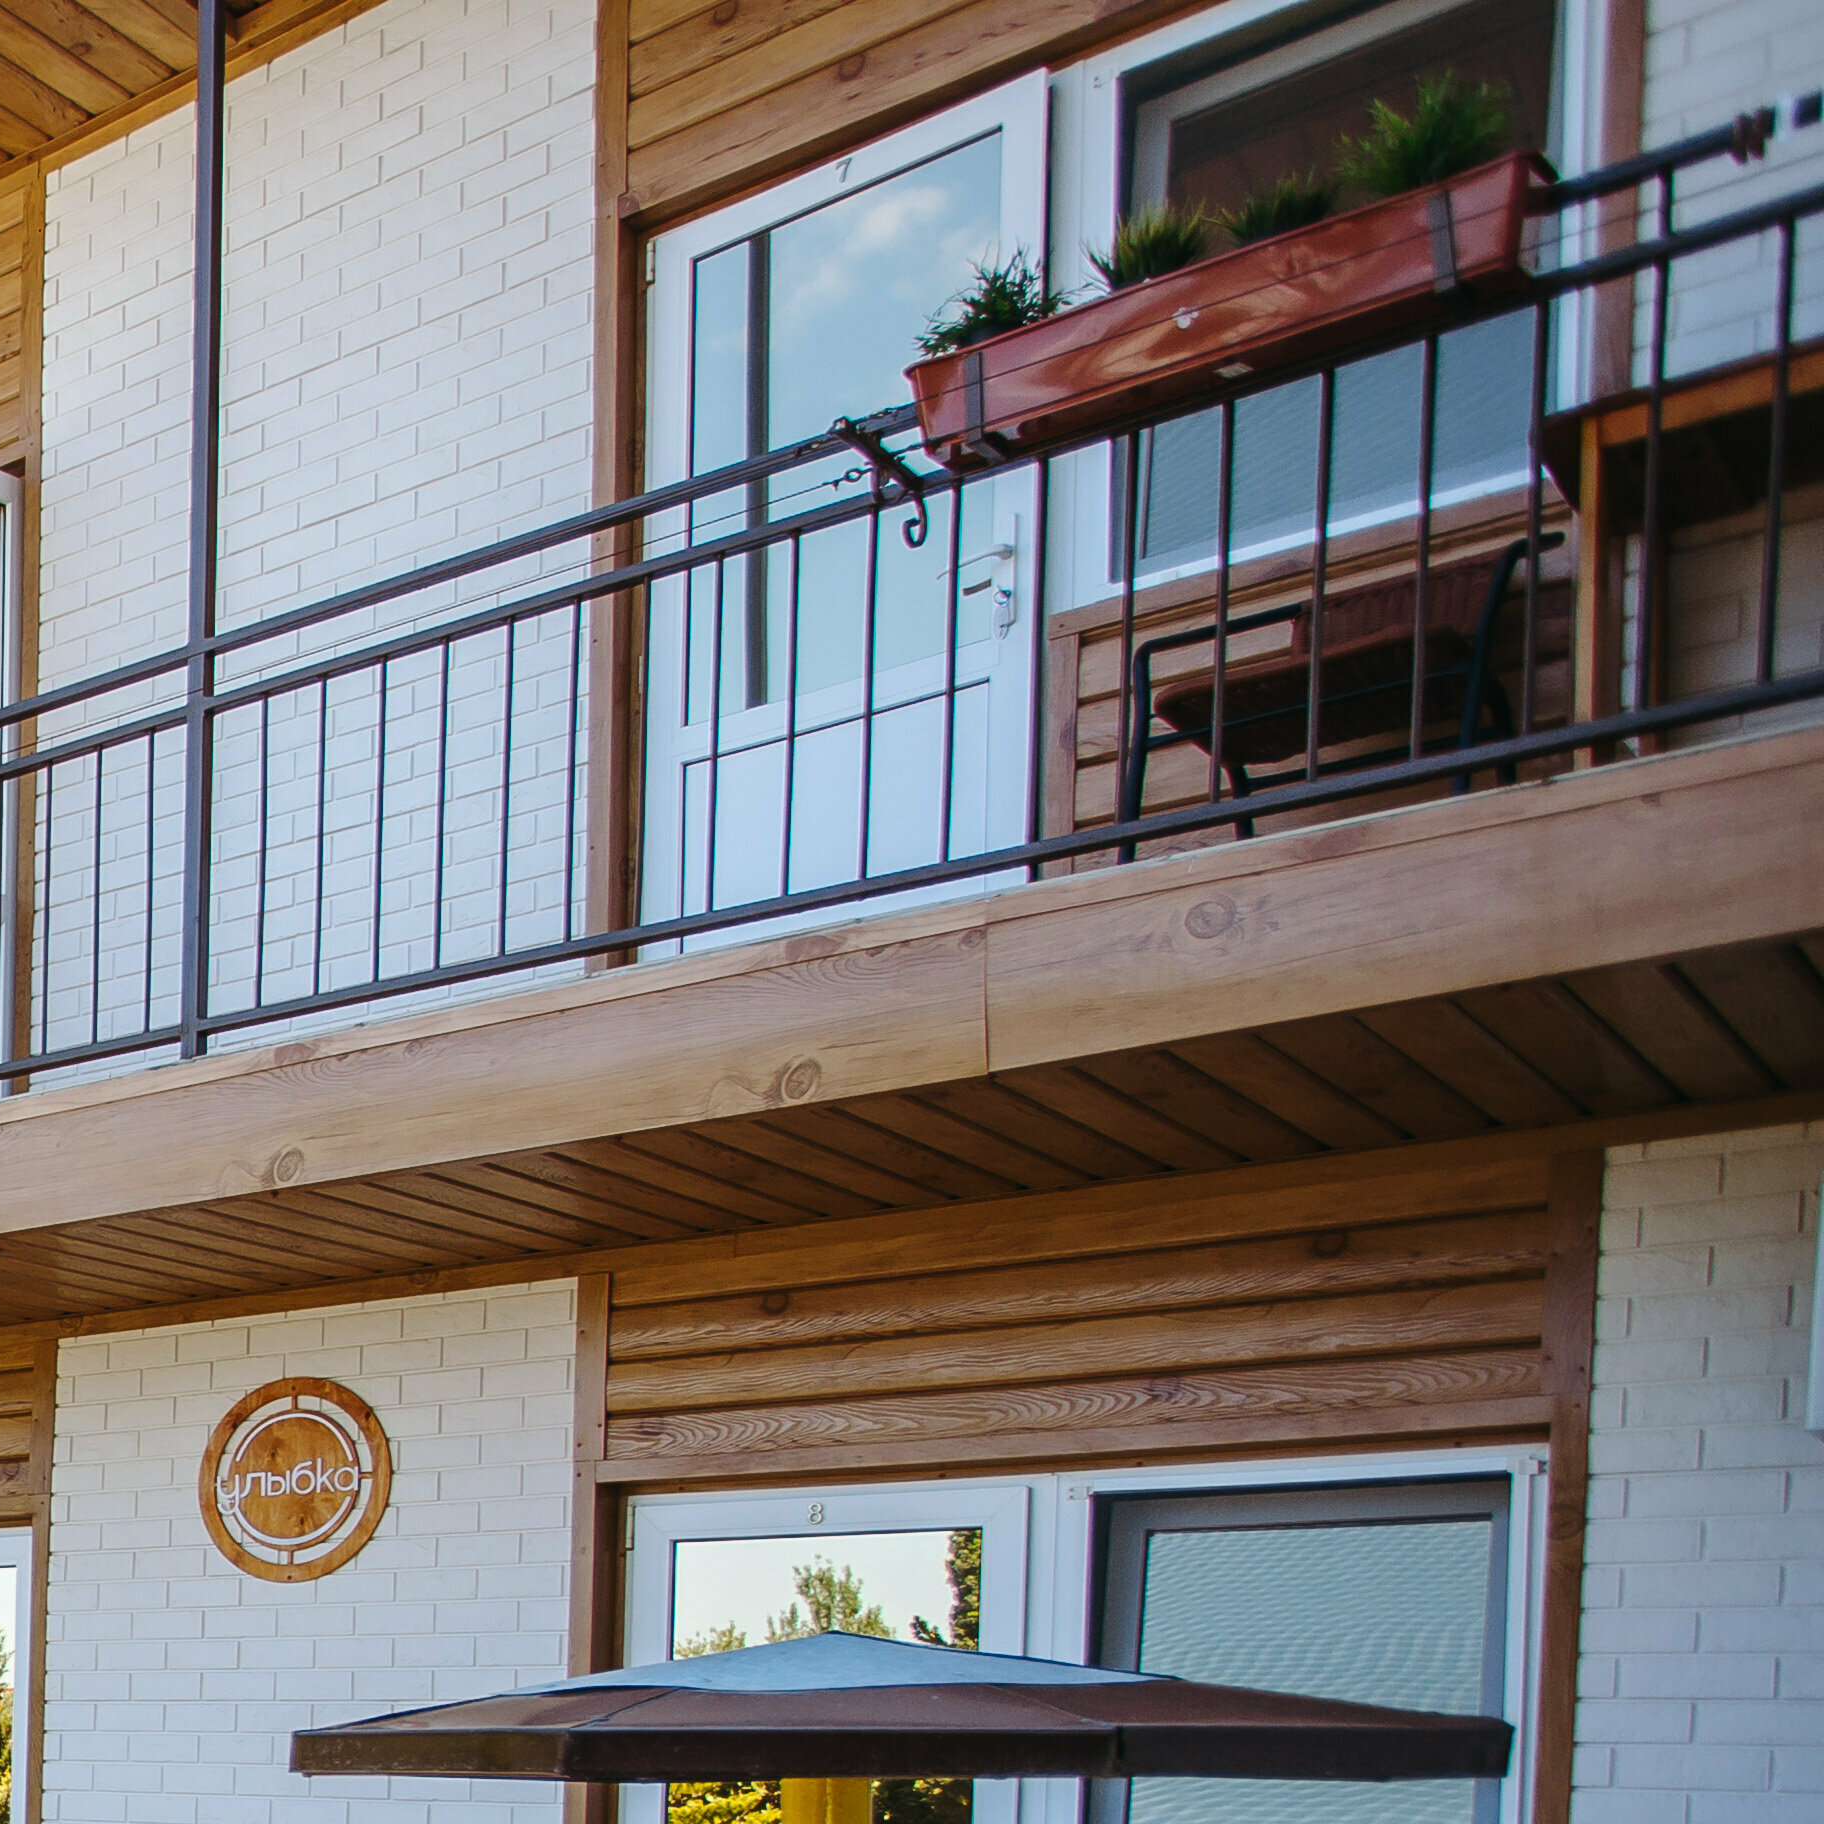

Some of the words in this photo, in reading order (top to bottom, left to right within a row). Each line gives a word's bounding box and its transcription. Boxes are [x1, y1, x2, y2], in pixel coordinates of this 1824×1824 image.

[835, 158, 852, 182] 7
[216, 1458, 359, 1515] улыбка
[807, 1503, 824, 1525] 8
